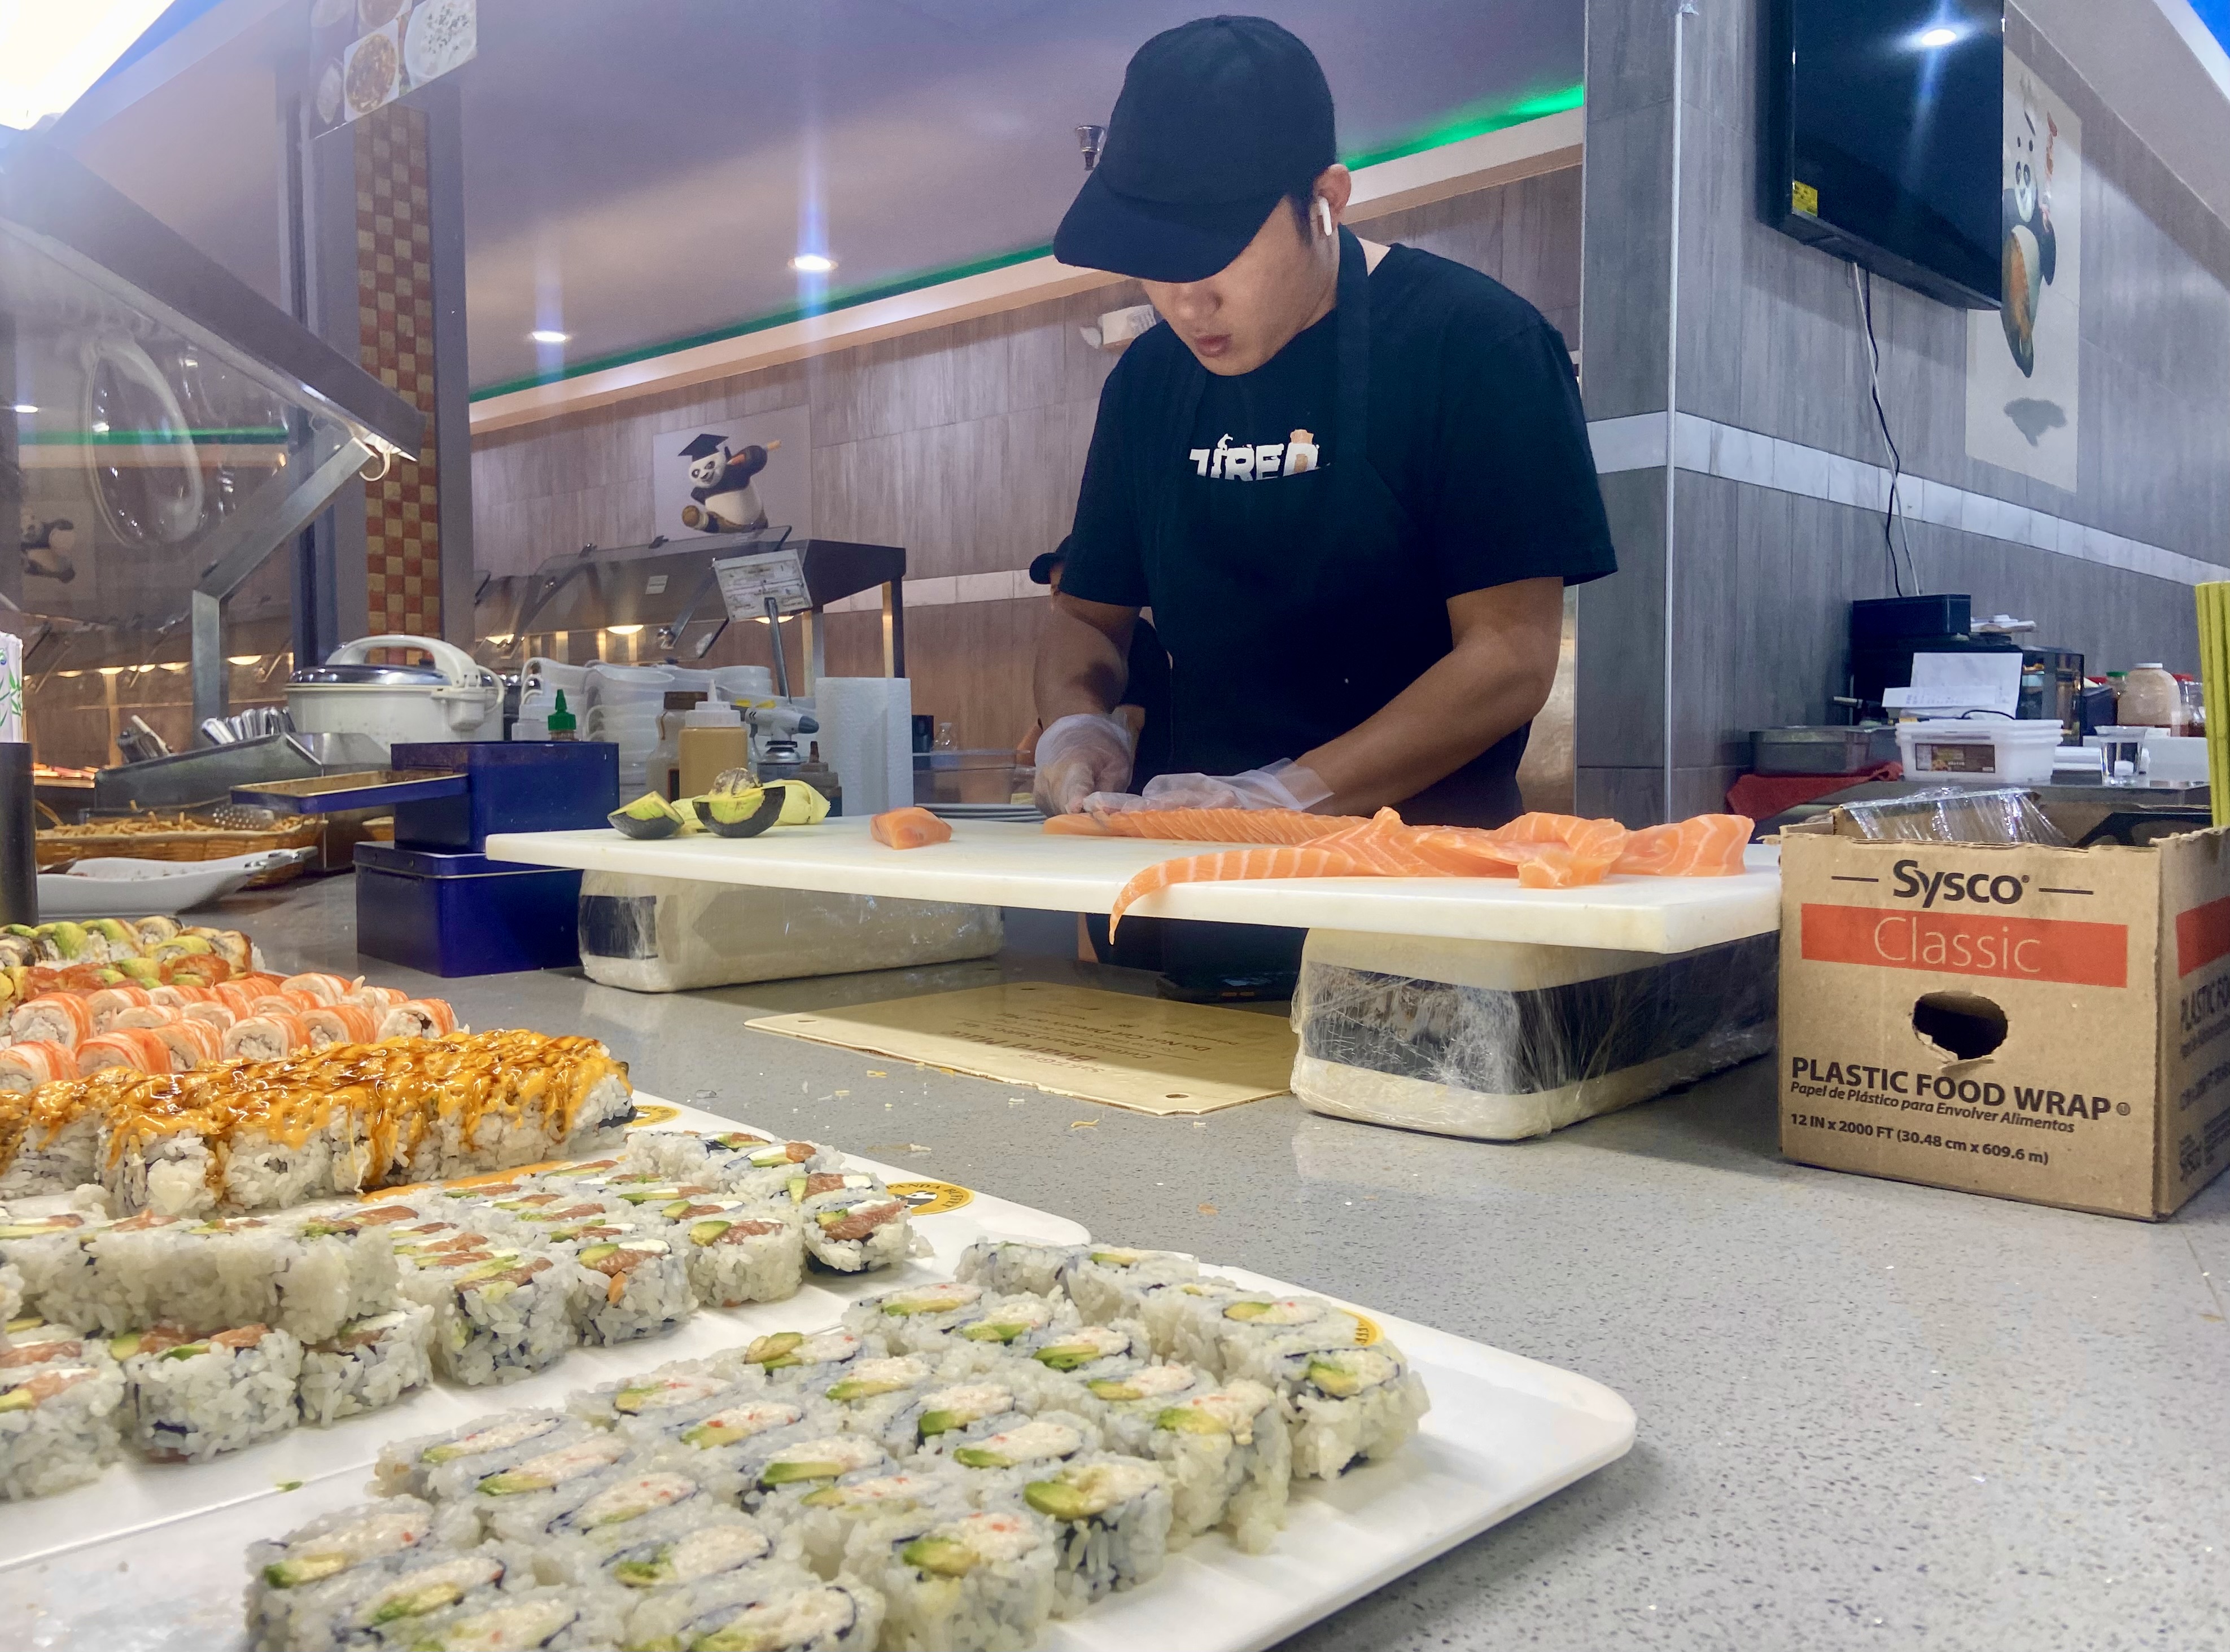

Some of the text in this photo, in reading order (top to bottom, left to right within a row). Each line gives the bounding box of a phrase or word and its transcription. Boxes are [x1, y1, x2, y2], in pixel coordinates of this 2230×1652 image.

[1893, 860, 2023, 908] Sysco
[1874, 917, 2040, 972] Classic
[1002, 1042, 1098, 1062] Board
[1033, 1036, 1086, 1047] Board
[1086, 1044, 1152, 1059] Cutting
[1791, 1081, 2075, 1133] Papel de Plástico para Envolver Alimentos
[1792, 1057, 2111, 1120] PLASTIC FOOD WRAP
[1791, 1114, 2048, 1165] 12 IN x 2000 FT (30.48 cm x 609.6 m)
